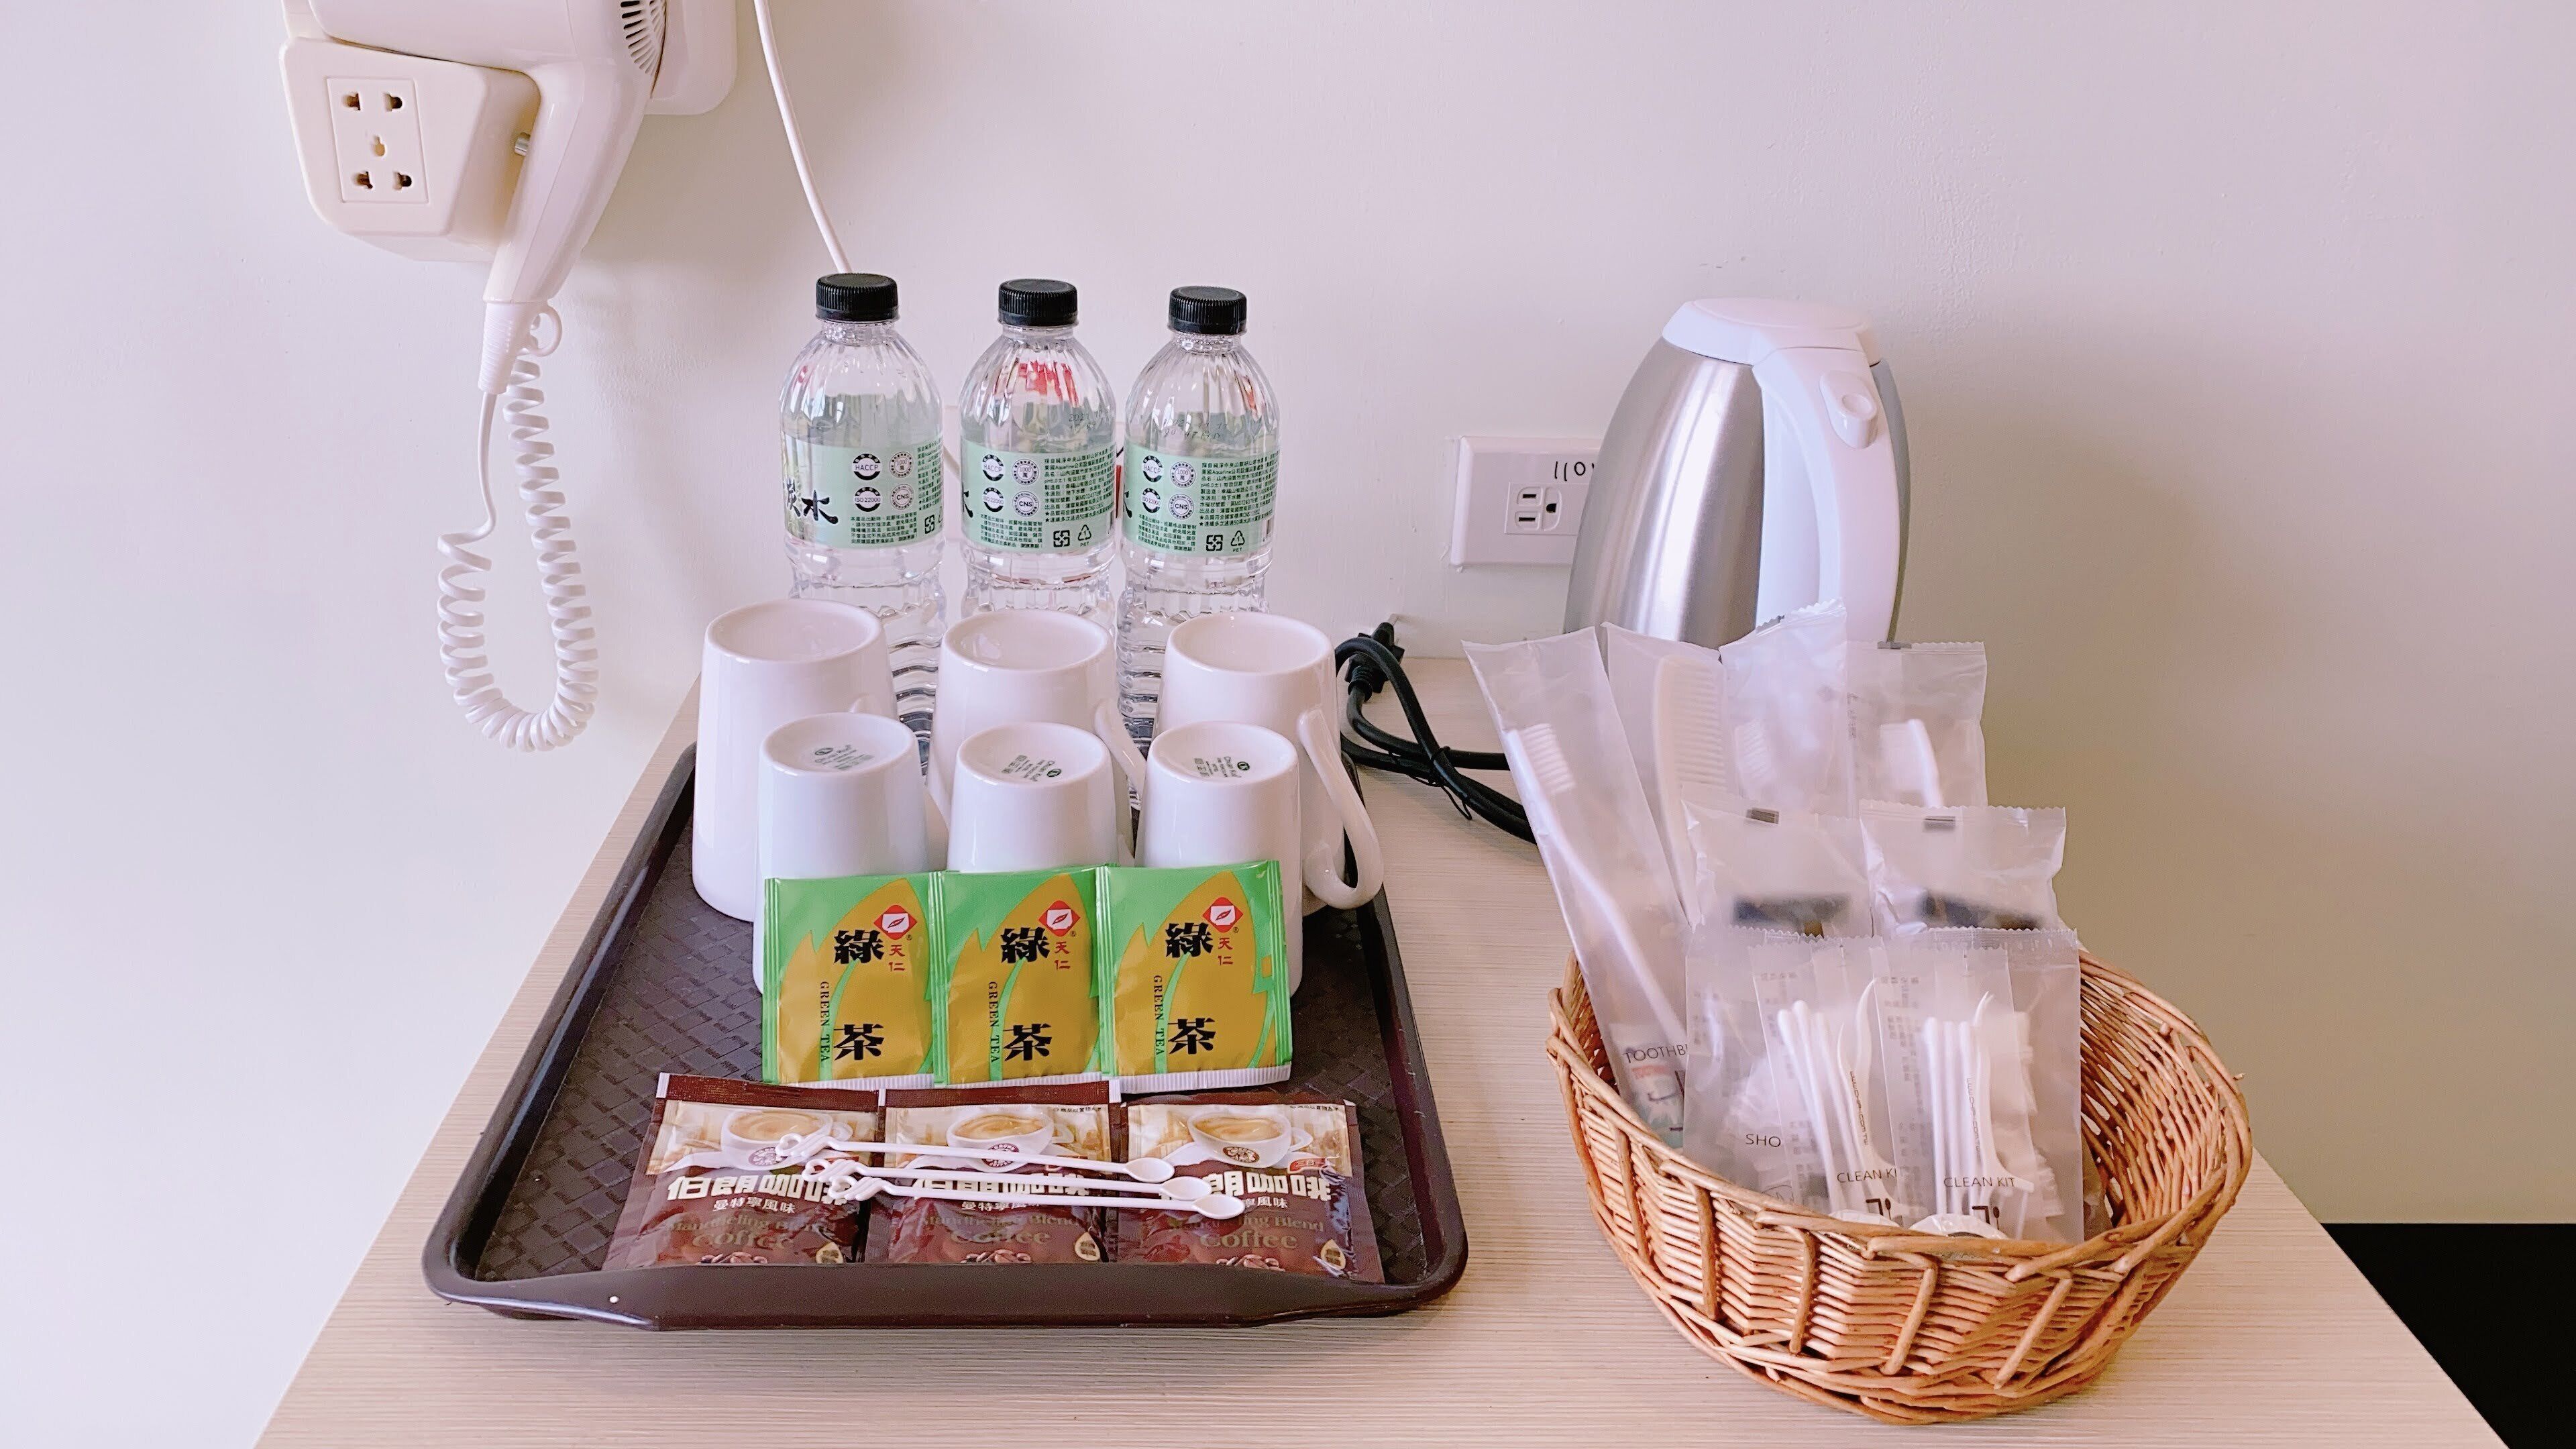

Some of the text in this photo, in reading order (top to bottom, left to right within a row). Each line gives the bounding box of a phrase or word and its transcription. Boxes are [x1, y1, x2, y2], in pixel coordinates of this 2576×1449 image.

[983, 464, 1002, 473] HACCP
[1143, 464, 1161, 474] HACCP
[1554, 460, 1595, 482] 110
[889, 945, 906, 972] 天仁
[1055, 941, 1071, 970] 天仁
[1218, 936, 1234, 966] 天仁
[820, 981, 830, 1062] GREEN TEA
[988, 981, 1000, 1063] GREEN TEA
[1153, 975, 1165, 1056] GREEN TEA
[1745, 1134, 1782, 1148] SHO
[1837, 1169, 1882, 1183] CLEAN
[1943, 1177, 2015, 1188] CLEAN KIT
[1275, 1215, 1324, 1232] Blend
